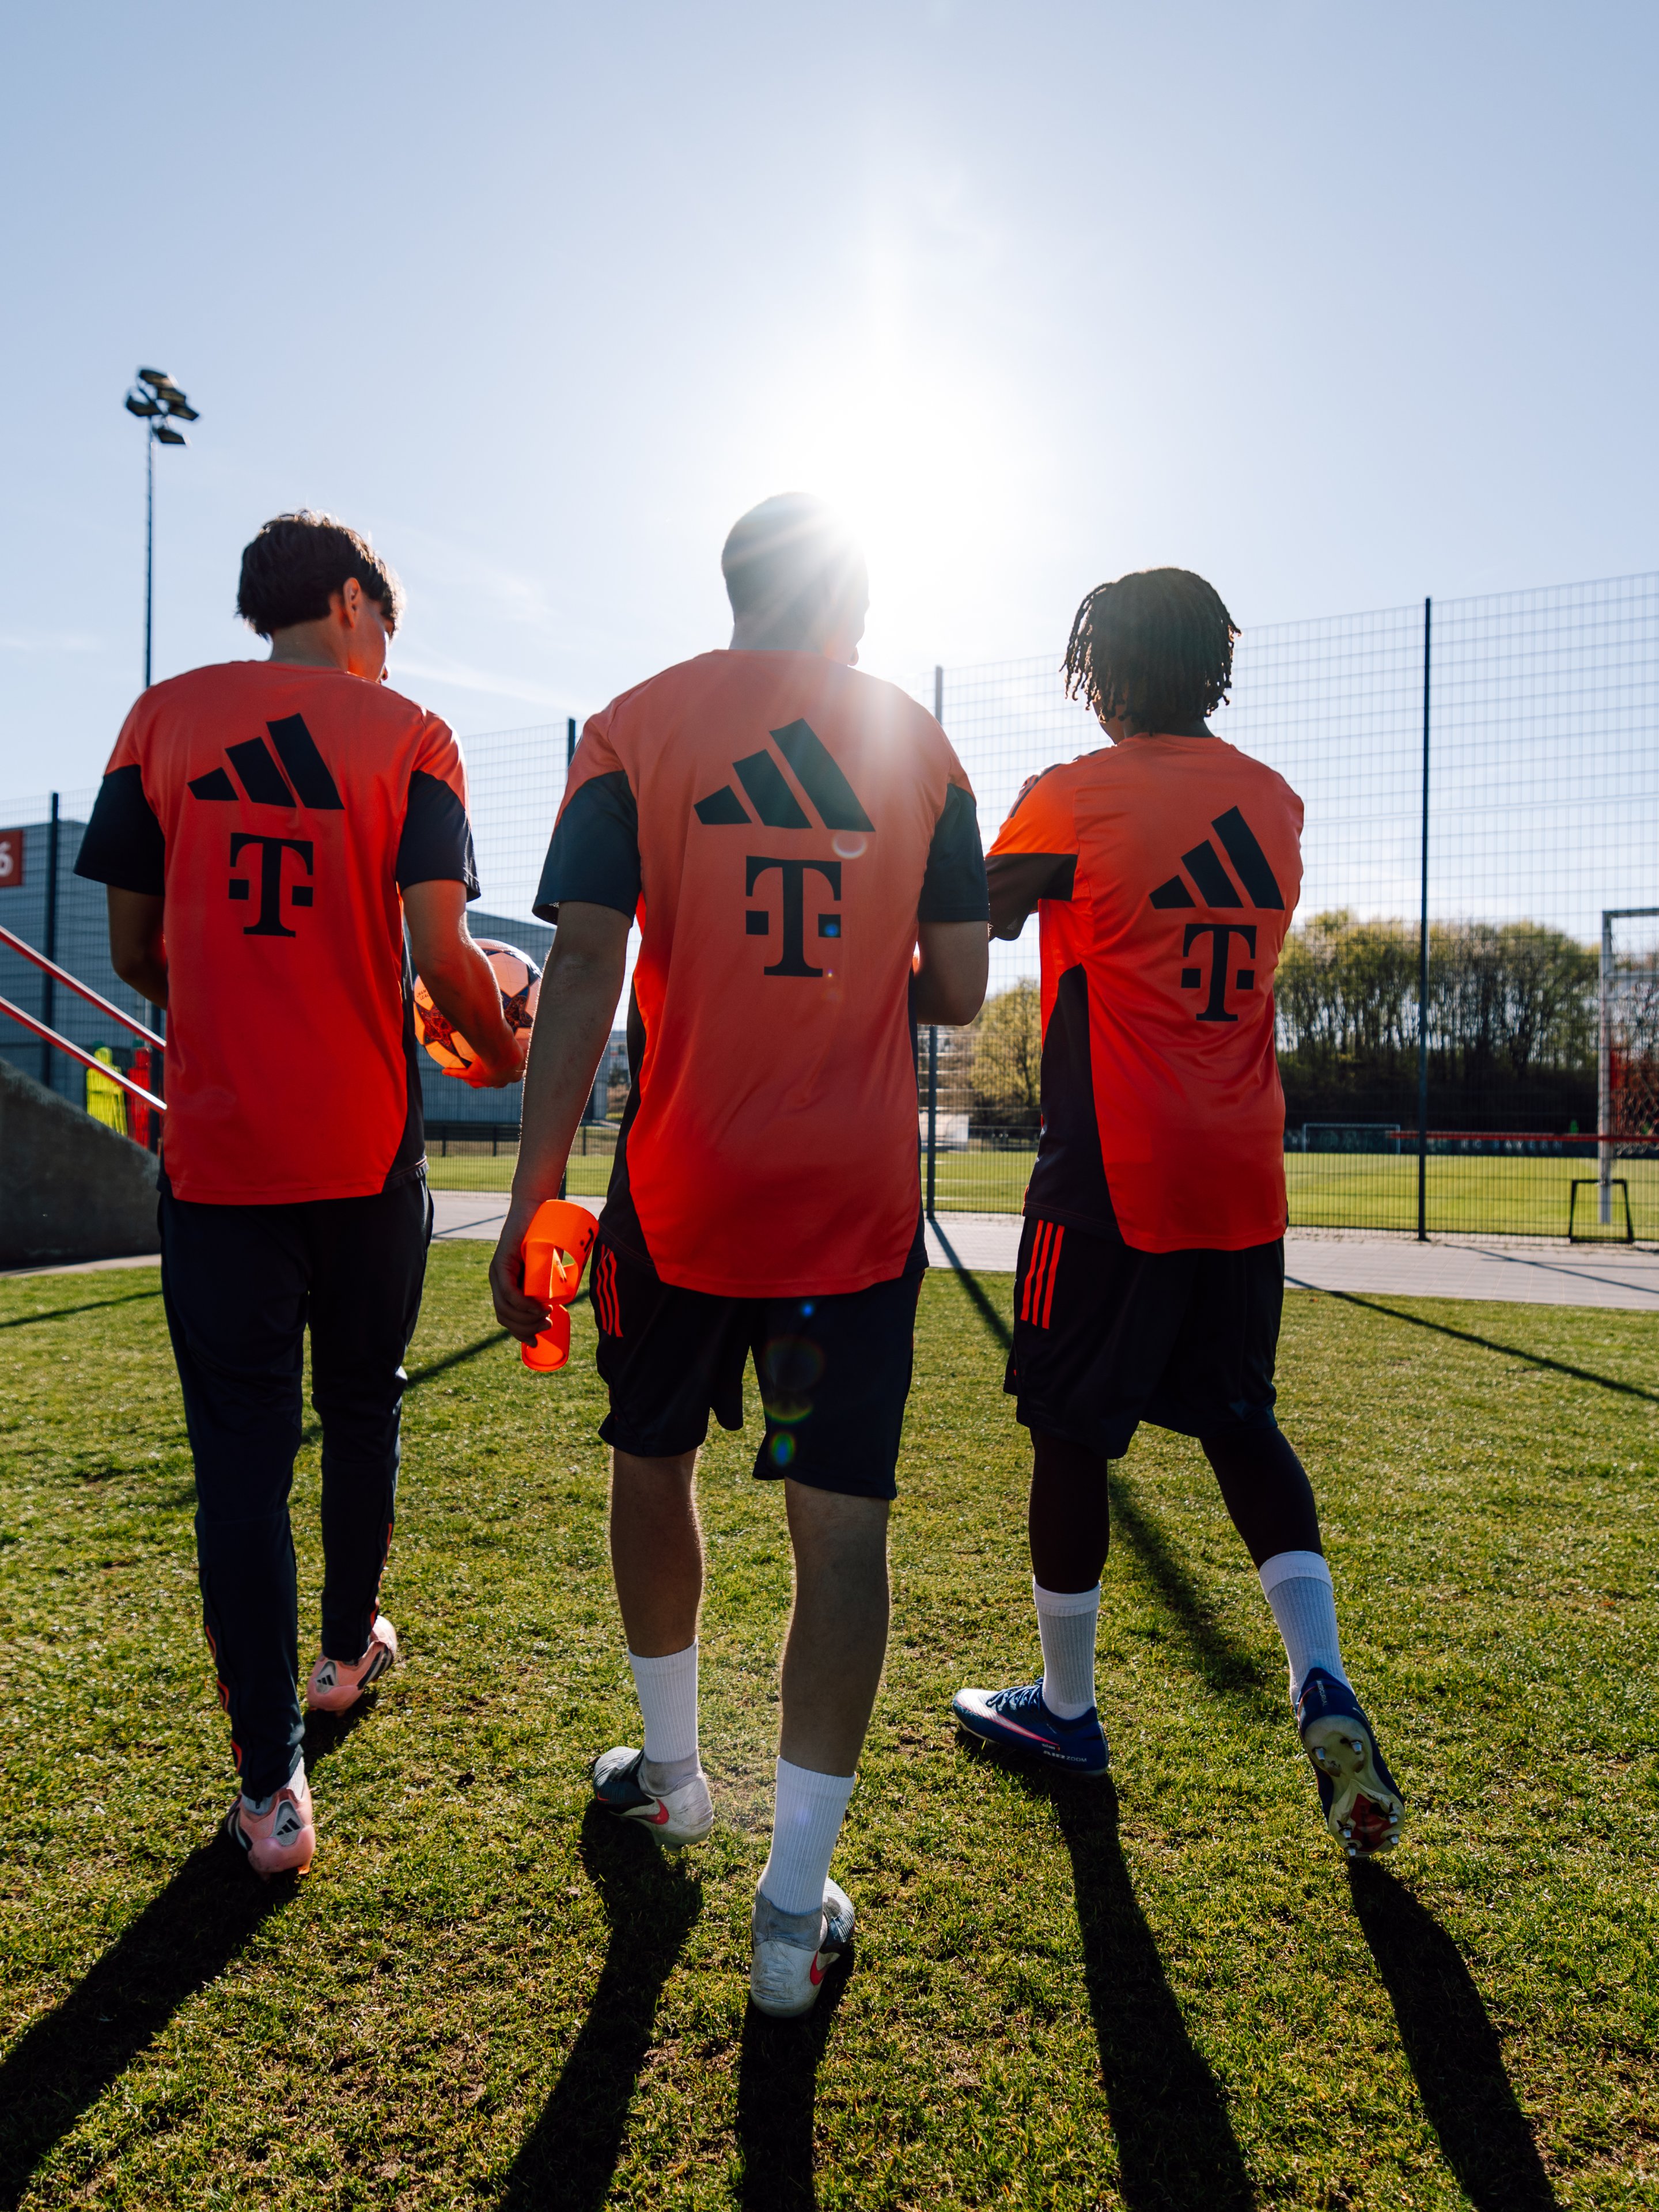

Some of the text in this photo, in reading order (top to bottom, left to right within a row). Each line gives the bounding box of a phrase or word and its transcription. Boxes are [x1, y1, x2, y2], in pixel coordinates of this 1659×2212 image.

[229, 832, 313, 937] T
[746, 856, 841, 977] T
[1181, 924, 1257, 1021] T
[1316, 1680, 1327, 1706] MERCURIAL
[1043, 1751, 1065, 1759] AIR
